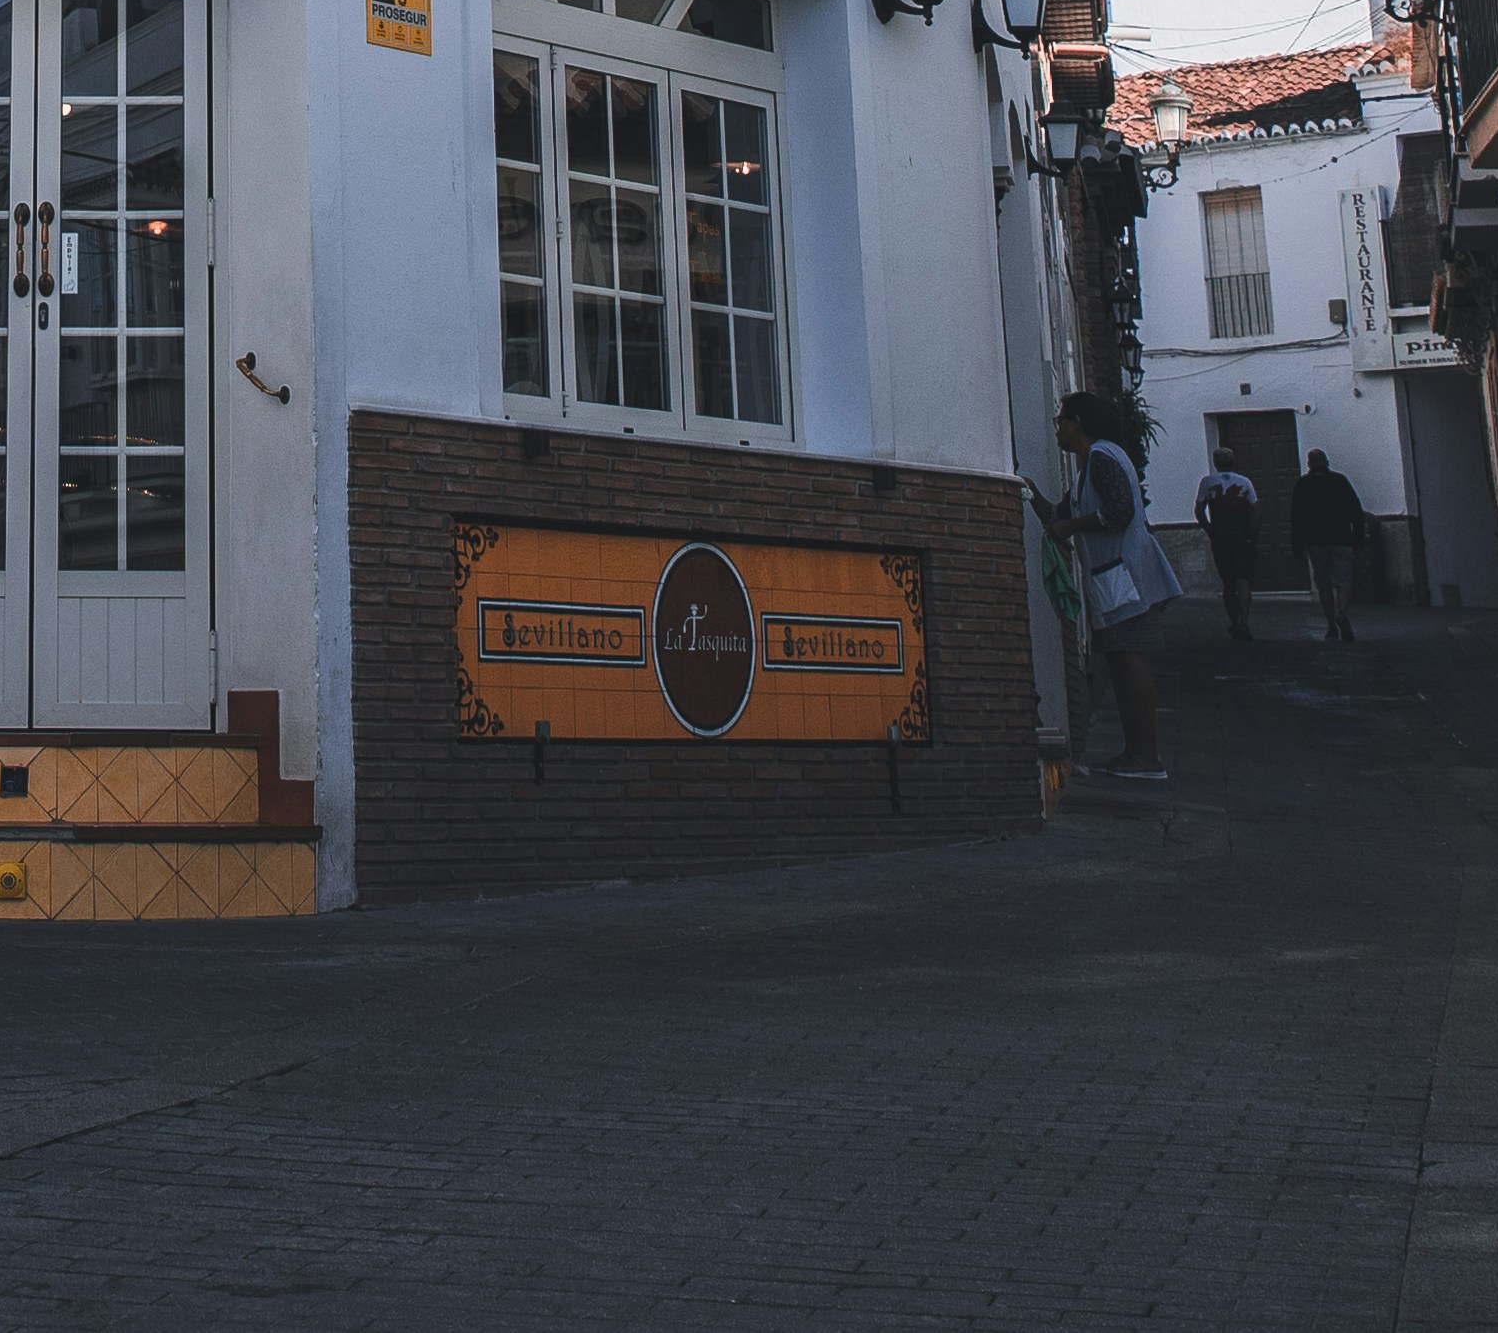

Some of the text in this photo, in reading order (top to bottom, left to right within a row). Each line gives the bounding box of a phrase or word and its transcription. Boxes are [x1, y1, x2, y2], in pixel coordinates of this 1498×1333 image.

[372, 3, 427, 26] PROSEGUR
[1352, 193, 1376, 332] RESTAURANTE
[502, 613, 623, 651] Sevillano
[664, 604, 747, 662] La Tasquita
[782, 627, 884, 660] Sevillano
